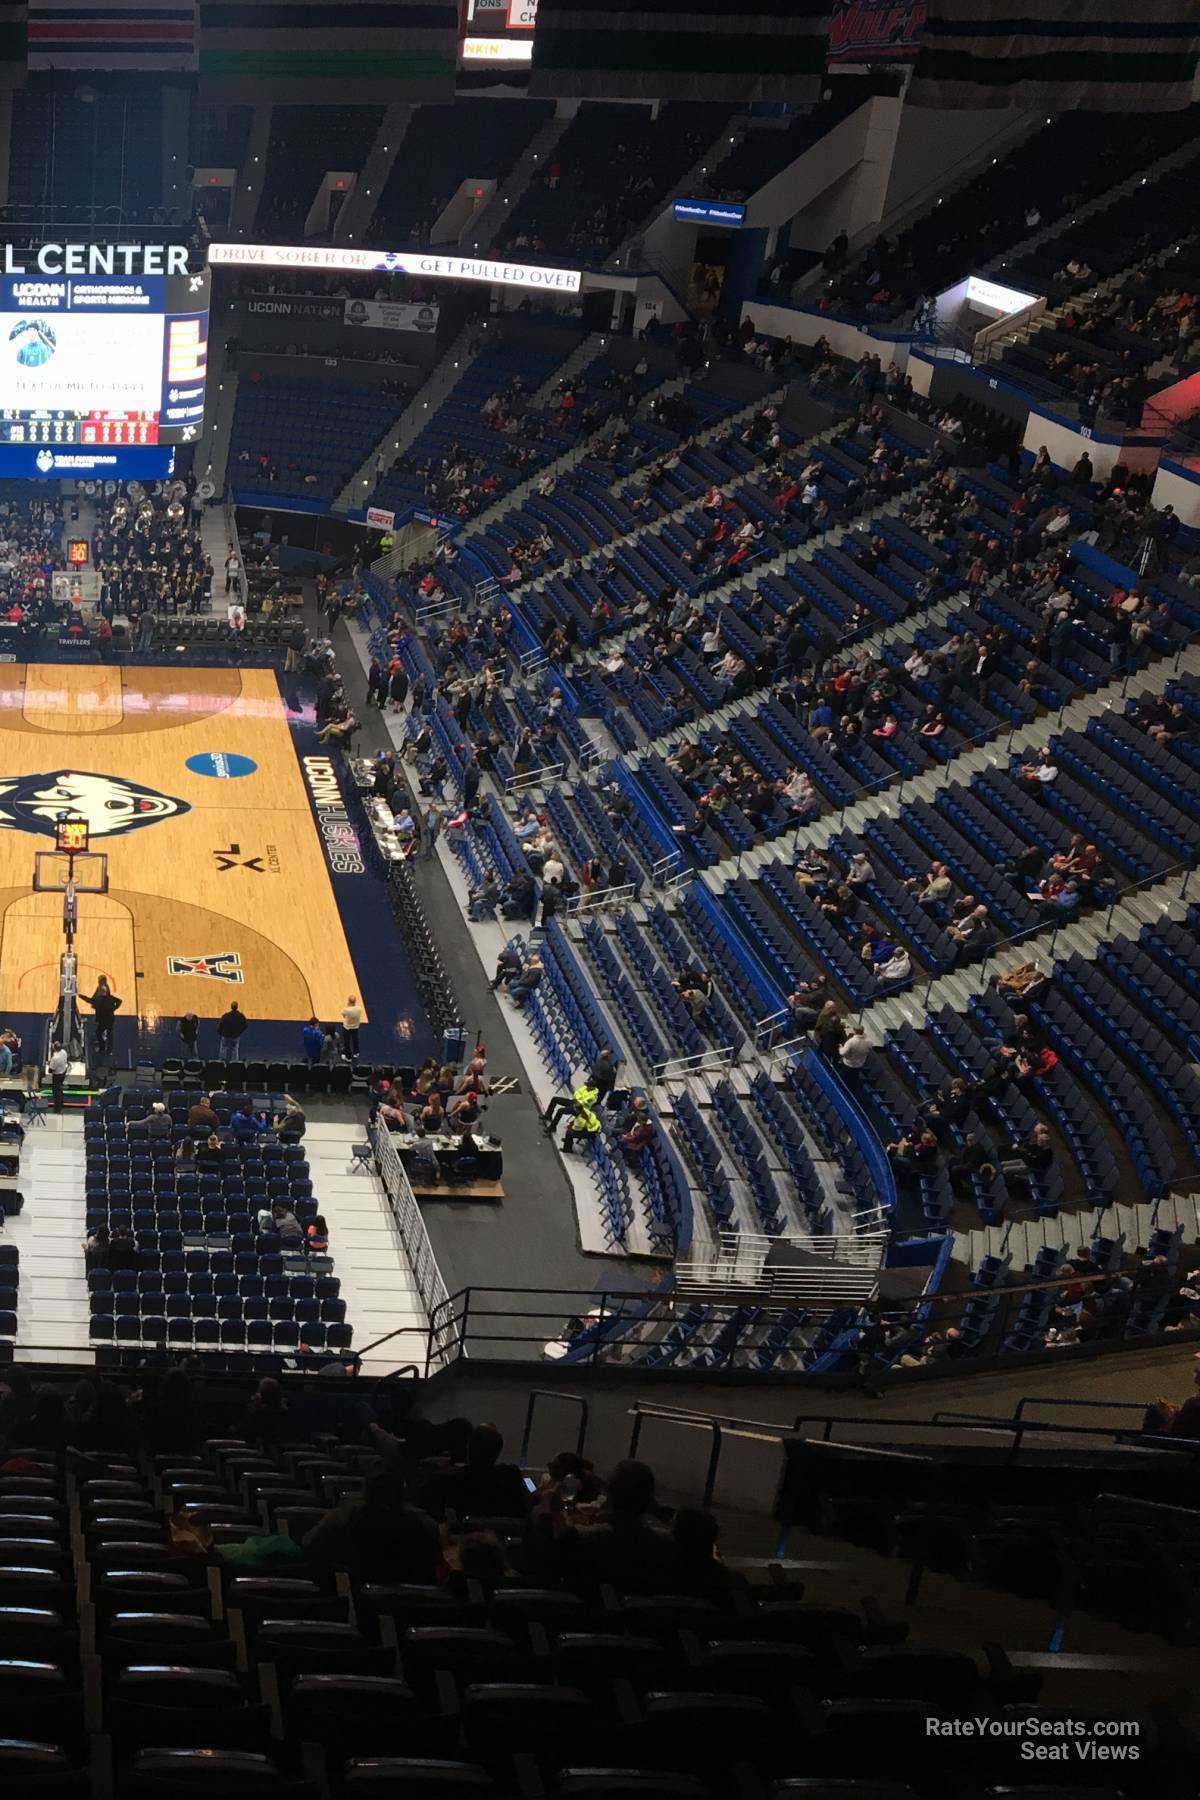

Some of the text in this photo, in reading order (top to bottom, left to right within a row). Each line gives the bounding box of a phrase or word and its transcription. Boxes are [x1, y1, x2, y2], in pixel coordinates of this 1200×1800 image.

[36, 243, 190, 275] CENTER
[215, 247, 578, 288] DRIVE SOBER OR GET PULLED OVER
[13, 283, 65, 297] UCONN
[18, 296, 59, 306] HEALTH
[73, 295, 107, 305] SPORTS
[248, 302, 291, 313] UCONN
[303, 755, 365, 874] UCONN HUSKIES
